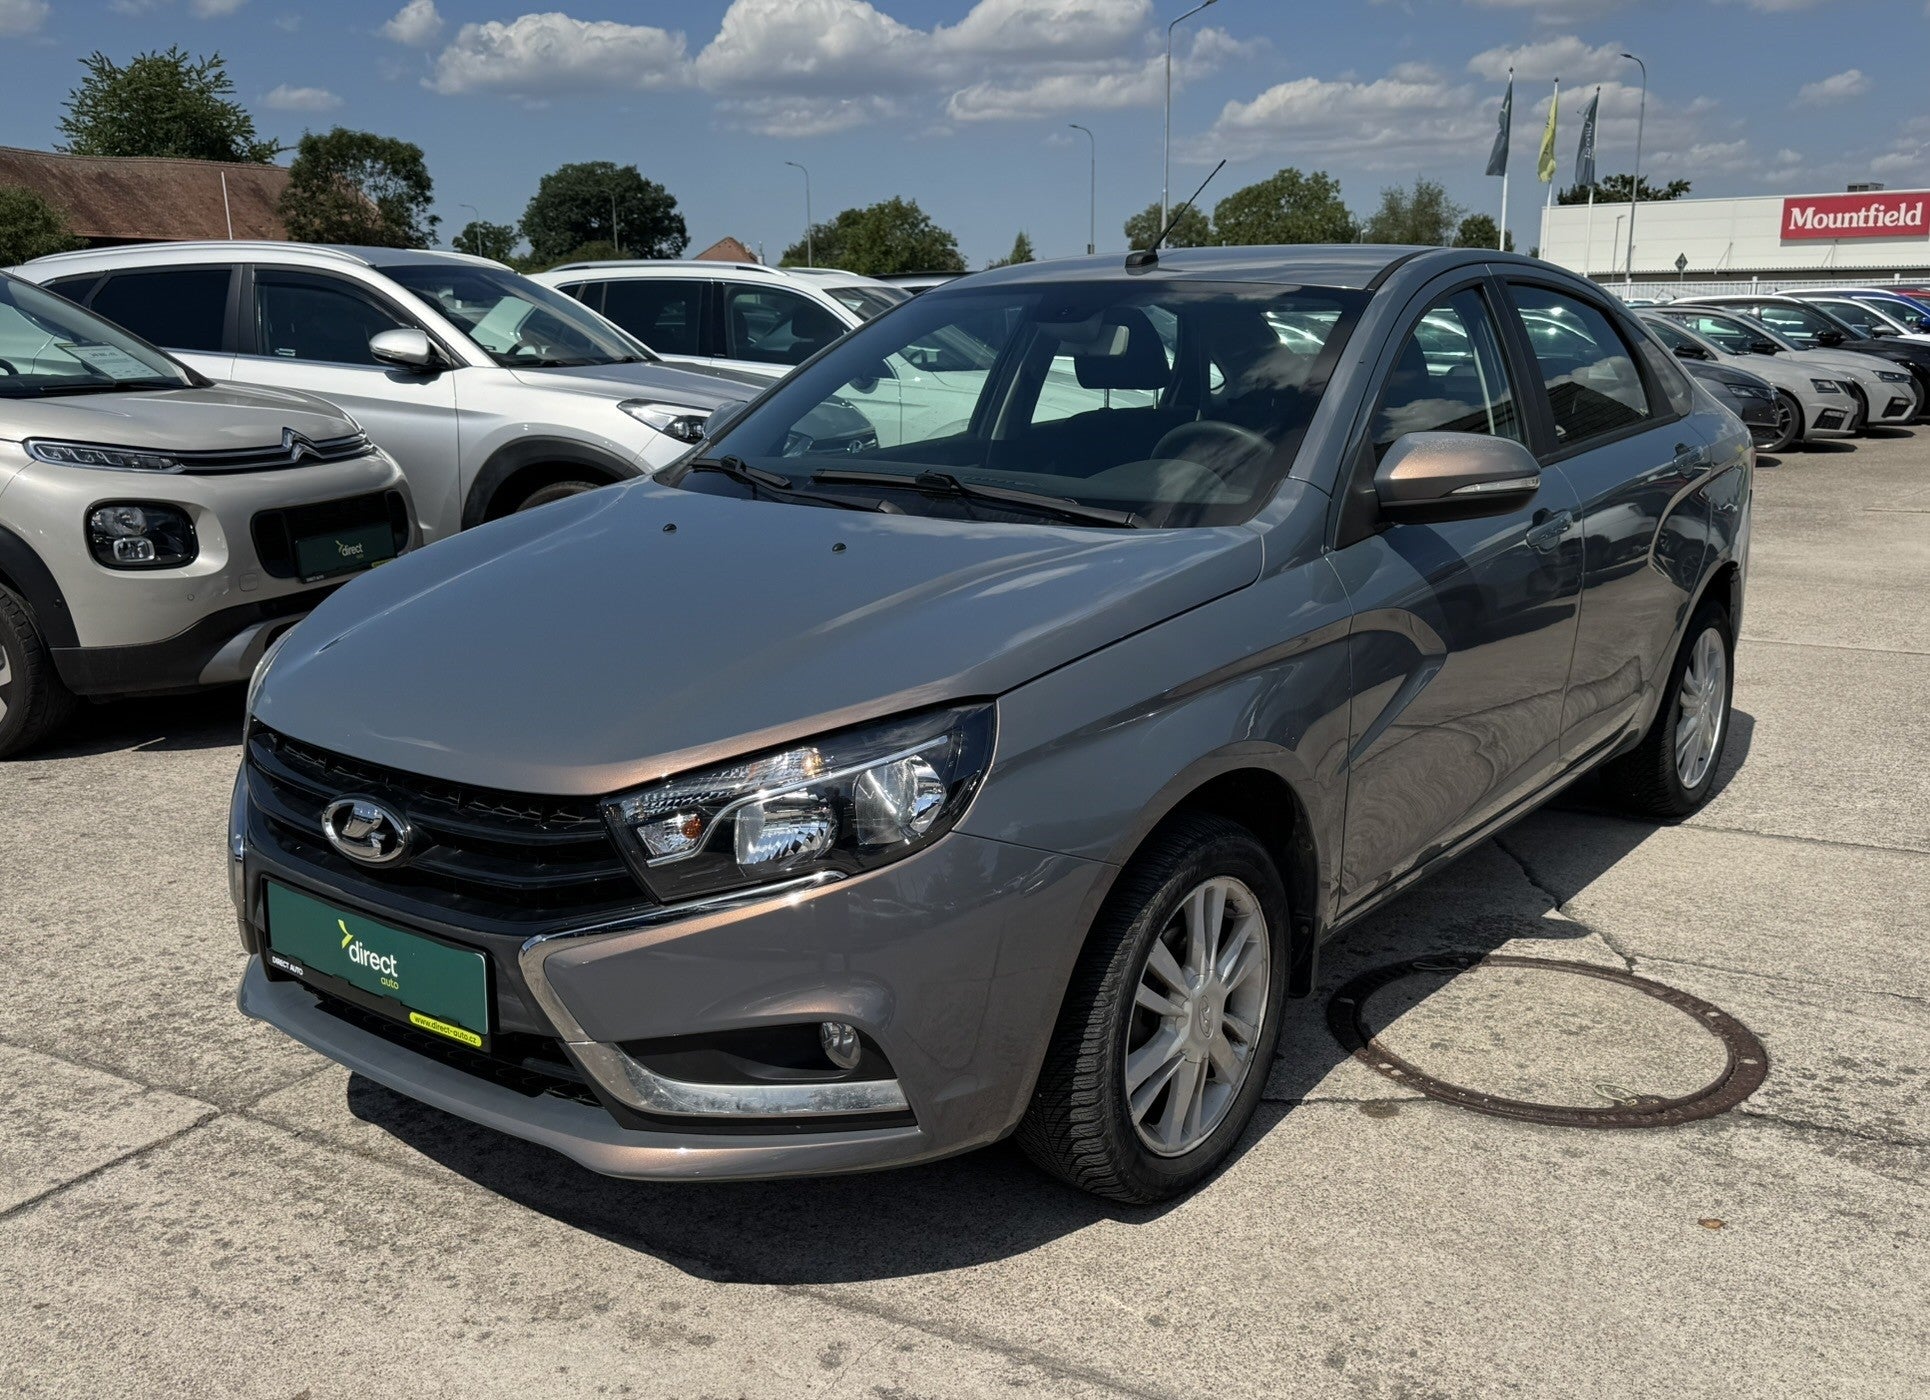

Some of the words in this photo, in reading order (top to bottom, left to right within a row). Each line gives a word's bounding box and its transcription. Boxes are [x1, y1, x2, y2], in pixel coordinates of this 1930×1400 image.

[1788, 201, 1923, 230] Mountfield
[341, 542, 364, 557] direct
[290, 963, 304, 976] AUTO
[348, 940, 398, 978] direct
[380, 976, 400, 990] auto
[413, 1015, 478, 1044] www.direct-auto.cz
